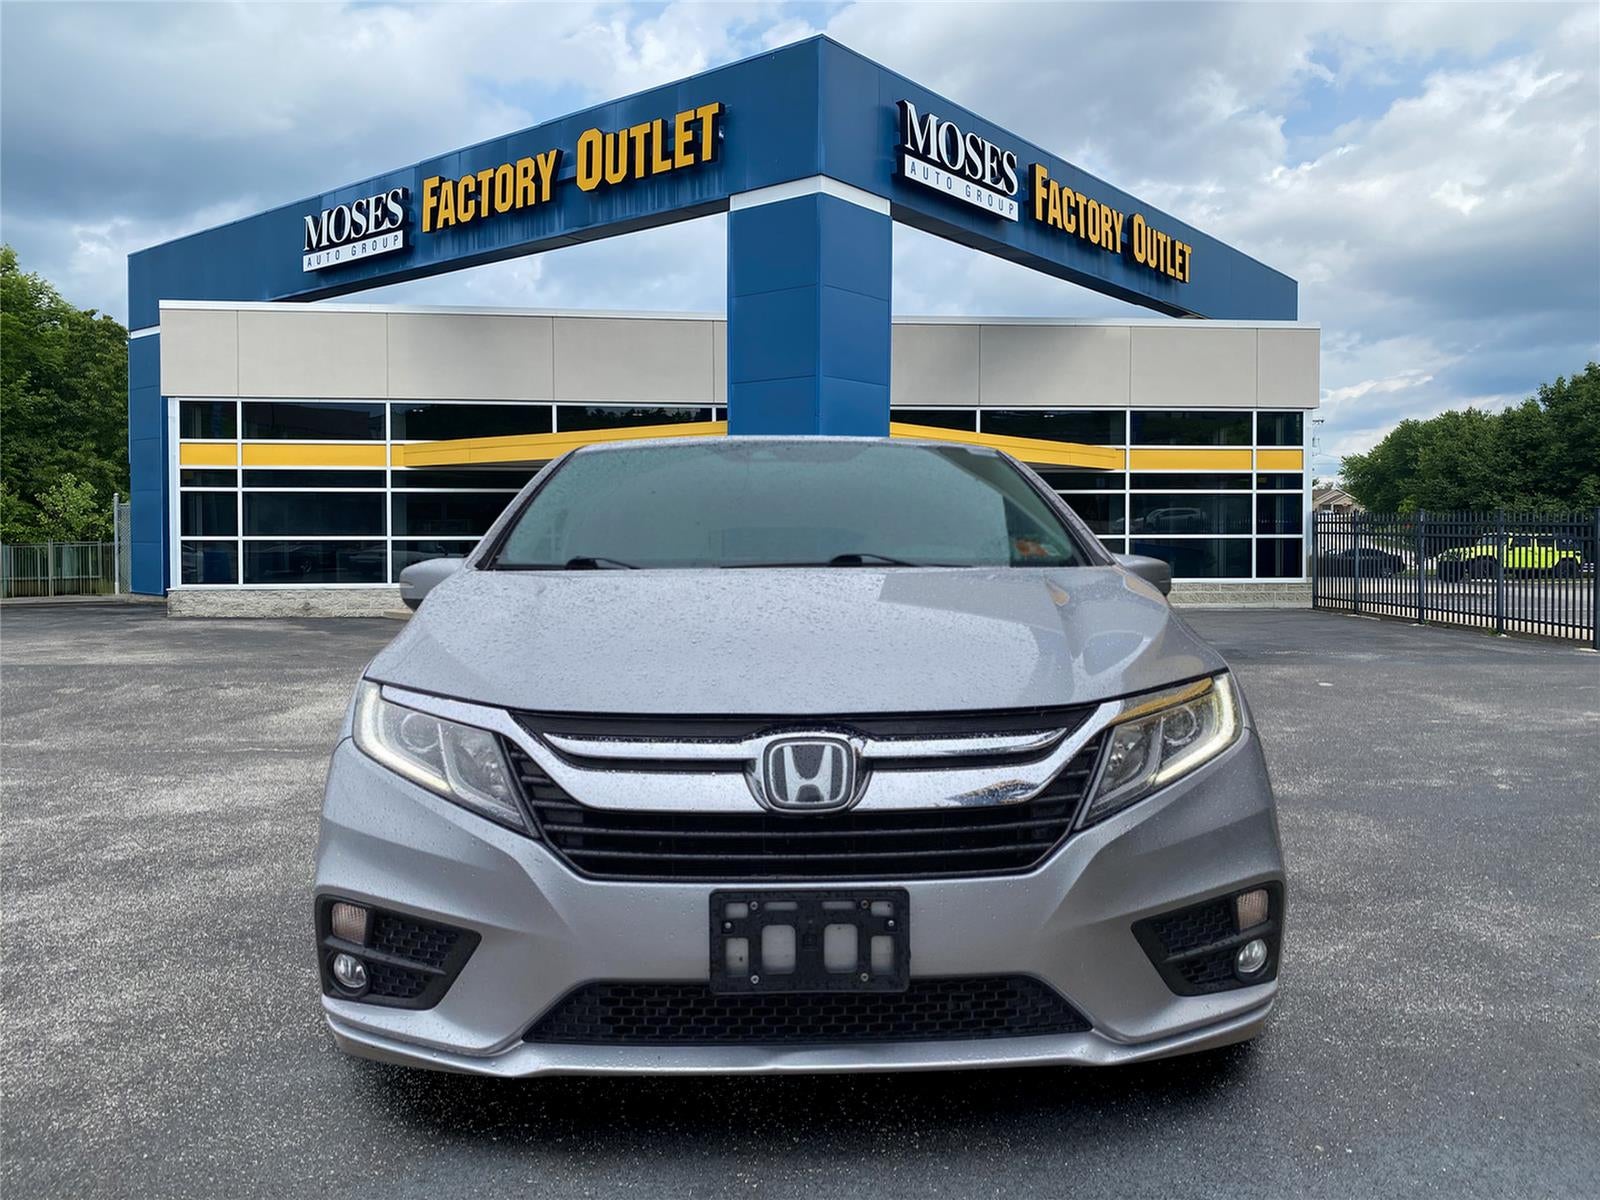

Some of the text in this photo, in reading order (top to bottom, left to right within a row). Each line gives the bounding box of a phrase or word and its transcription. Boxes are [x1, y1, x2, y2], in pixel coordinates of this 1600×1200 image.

[422, 101, 721, 233] FACTORY OUTLET
[903, 99, 1019, 197] MOSES
[910, 160, 1015, 215] AUTO GROUP
[303, 188, 404, 252] MOSES
[307, 234, 399, 267] AUTO GROUP
[1034, 163, 1193, 283] FACTORY OUTLET
